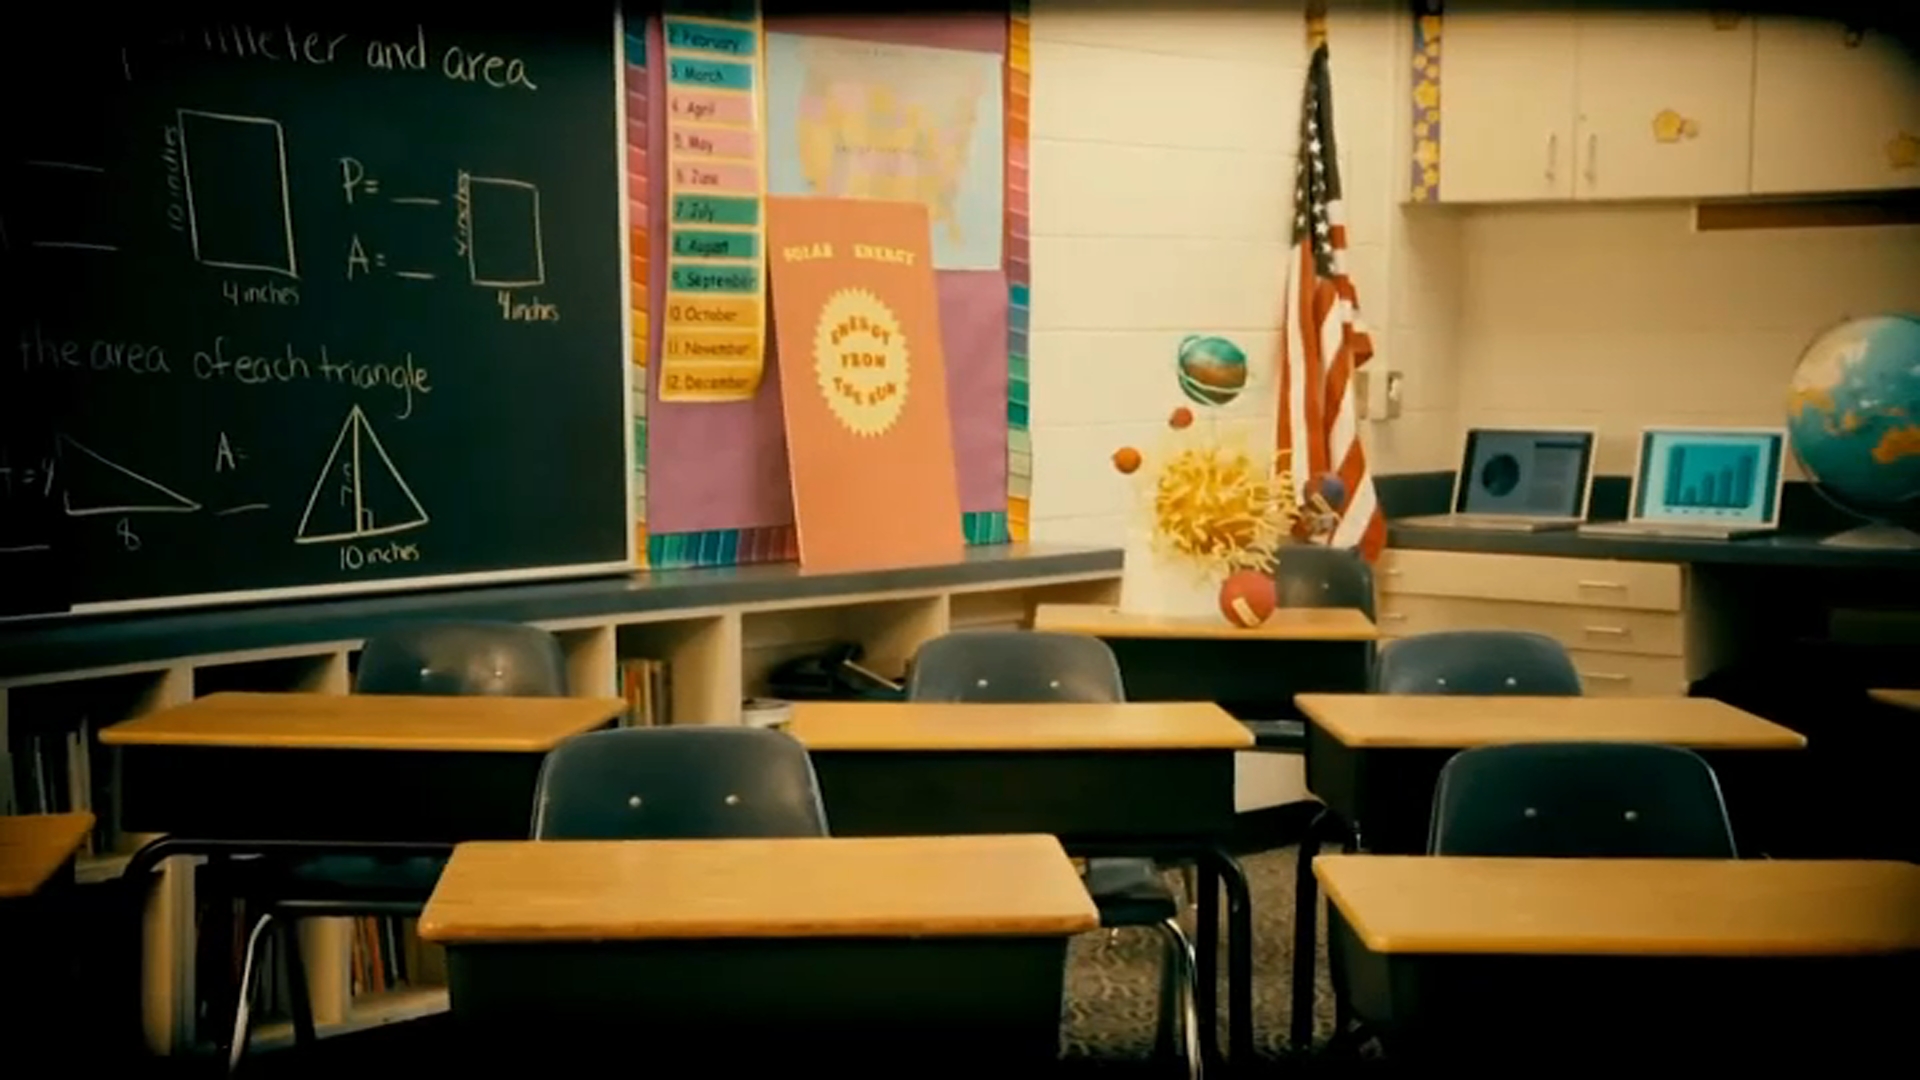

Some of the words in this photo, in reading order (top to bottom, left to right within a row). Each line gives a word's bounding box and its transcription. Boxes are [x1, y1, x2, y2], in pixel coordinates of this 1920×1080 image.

[367, 23, 427, 70] and
[442, 45, 538, 90] area
[684, 65, 725, 82] March
[686, 100, 717, 120] April
[688, 134, 713, 154] May
[690, 201, 714, 223] July
[689, 239, 729, 257] August
[782, 242, 833, 263] SOLAR
[853, 242, 916, 267] ENERGY
[686, 271, 755, 290] September
[685, 305, 738, 322] October
[831, 315, 891, 346] ENERGY
[684, 340, 751, 356] November
[18, 317, 82, 374] the
[89, 338, 172, 374] area
[192, 335, 232, 381] of
[233, 341, 311, 384] each
[318, 343, 433, 421] triangle
[841, 352, 886, 369] FROM
[684, 373, 751, 391] December
[832, 377, 862, 406] THE
[868, 382, 897, 406] SUN
[115, 517, 143, 552] 8
[339, 545, 365, 571] 10
